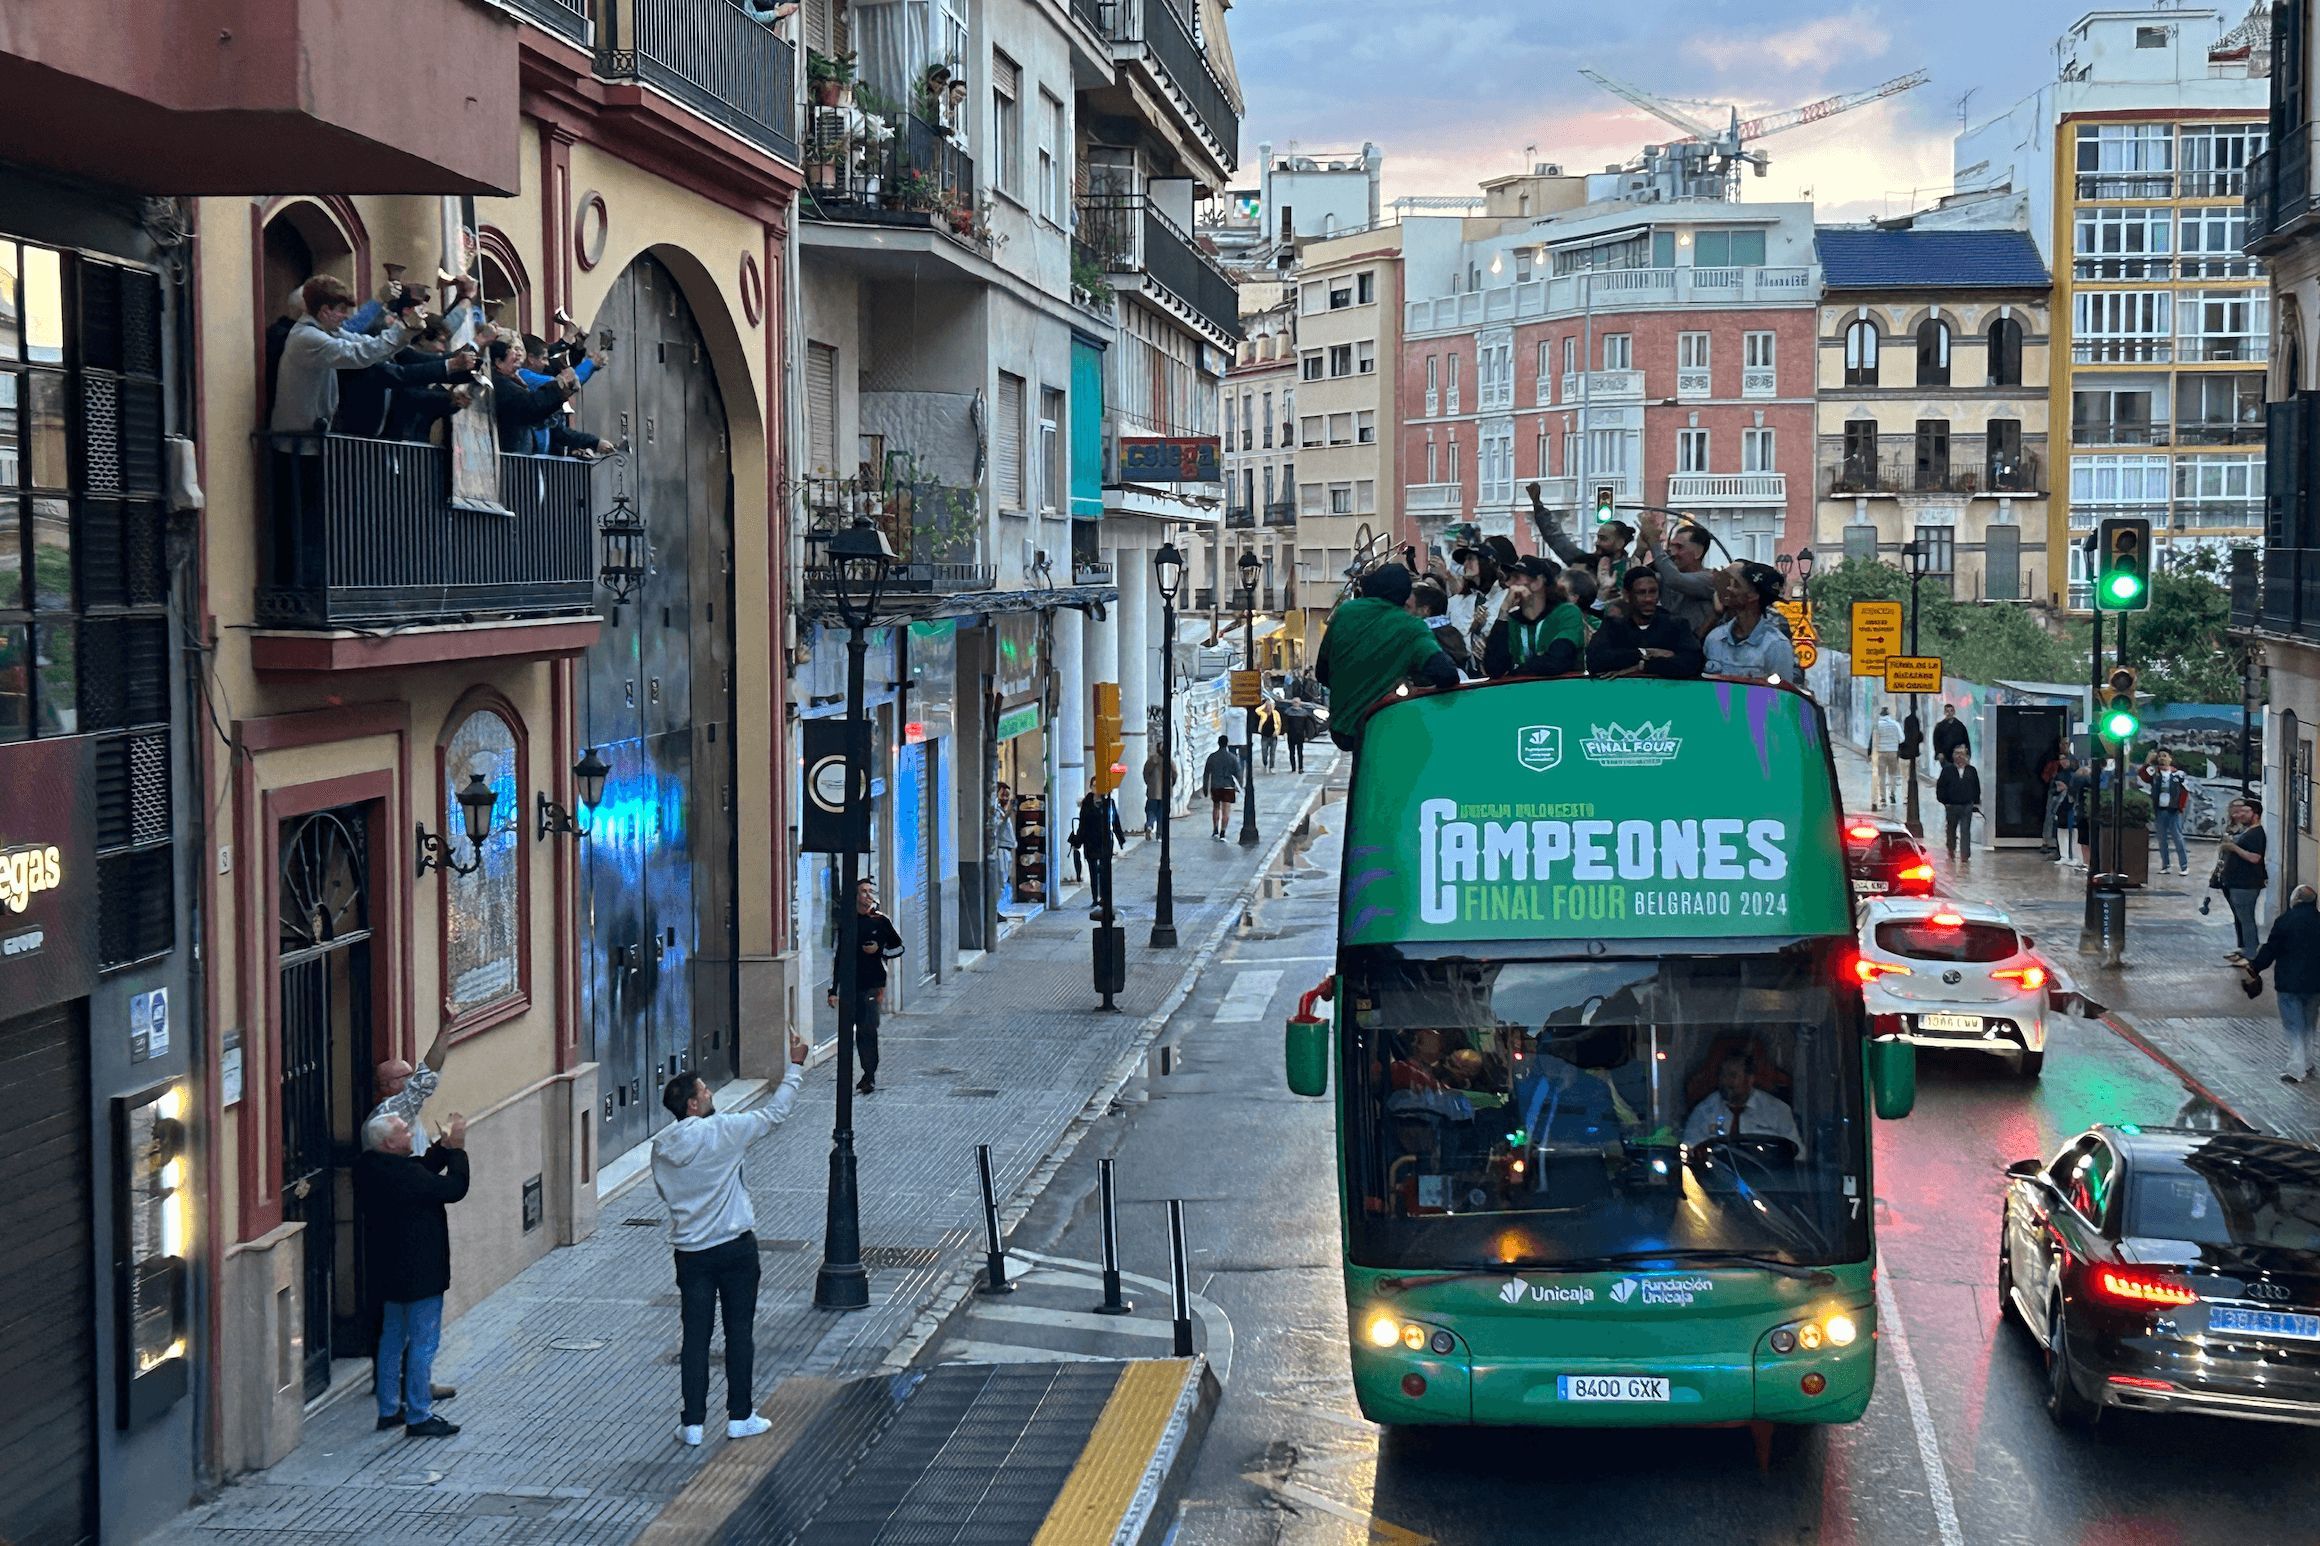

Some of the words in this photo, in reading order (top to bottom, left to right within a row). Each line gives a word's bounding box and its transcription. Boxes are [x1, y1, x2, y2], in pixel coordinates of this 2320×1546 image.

[1585, 741, 1632, 754] FINAL
[1634, 741, 1677, 753] FOUR
[1419, 798, 1789, 924] CAMPEONES
[1464, 884, 1545, 921] FINAL
[1552, 884, 1627, 921] FOUR
[1634, 890, 1730, 916] BELGRADO
[1739, 891, 1788, 917] 2024
[1848, 1197, 1861, 1220] 7
[1641, 1277, 1714, 1292] Fundación
[1530, 1285, 1595, 1305] Unicaja
[1641, 1288, 1695, 1307] Unicaja
[1575, 1379, 1621, 1398] 8400
[1628, 1379, 1663, 1398] GXK
